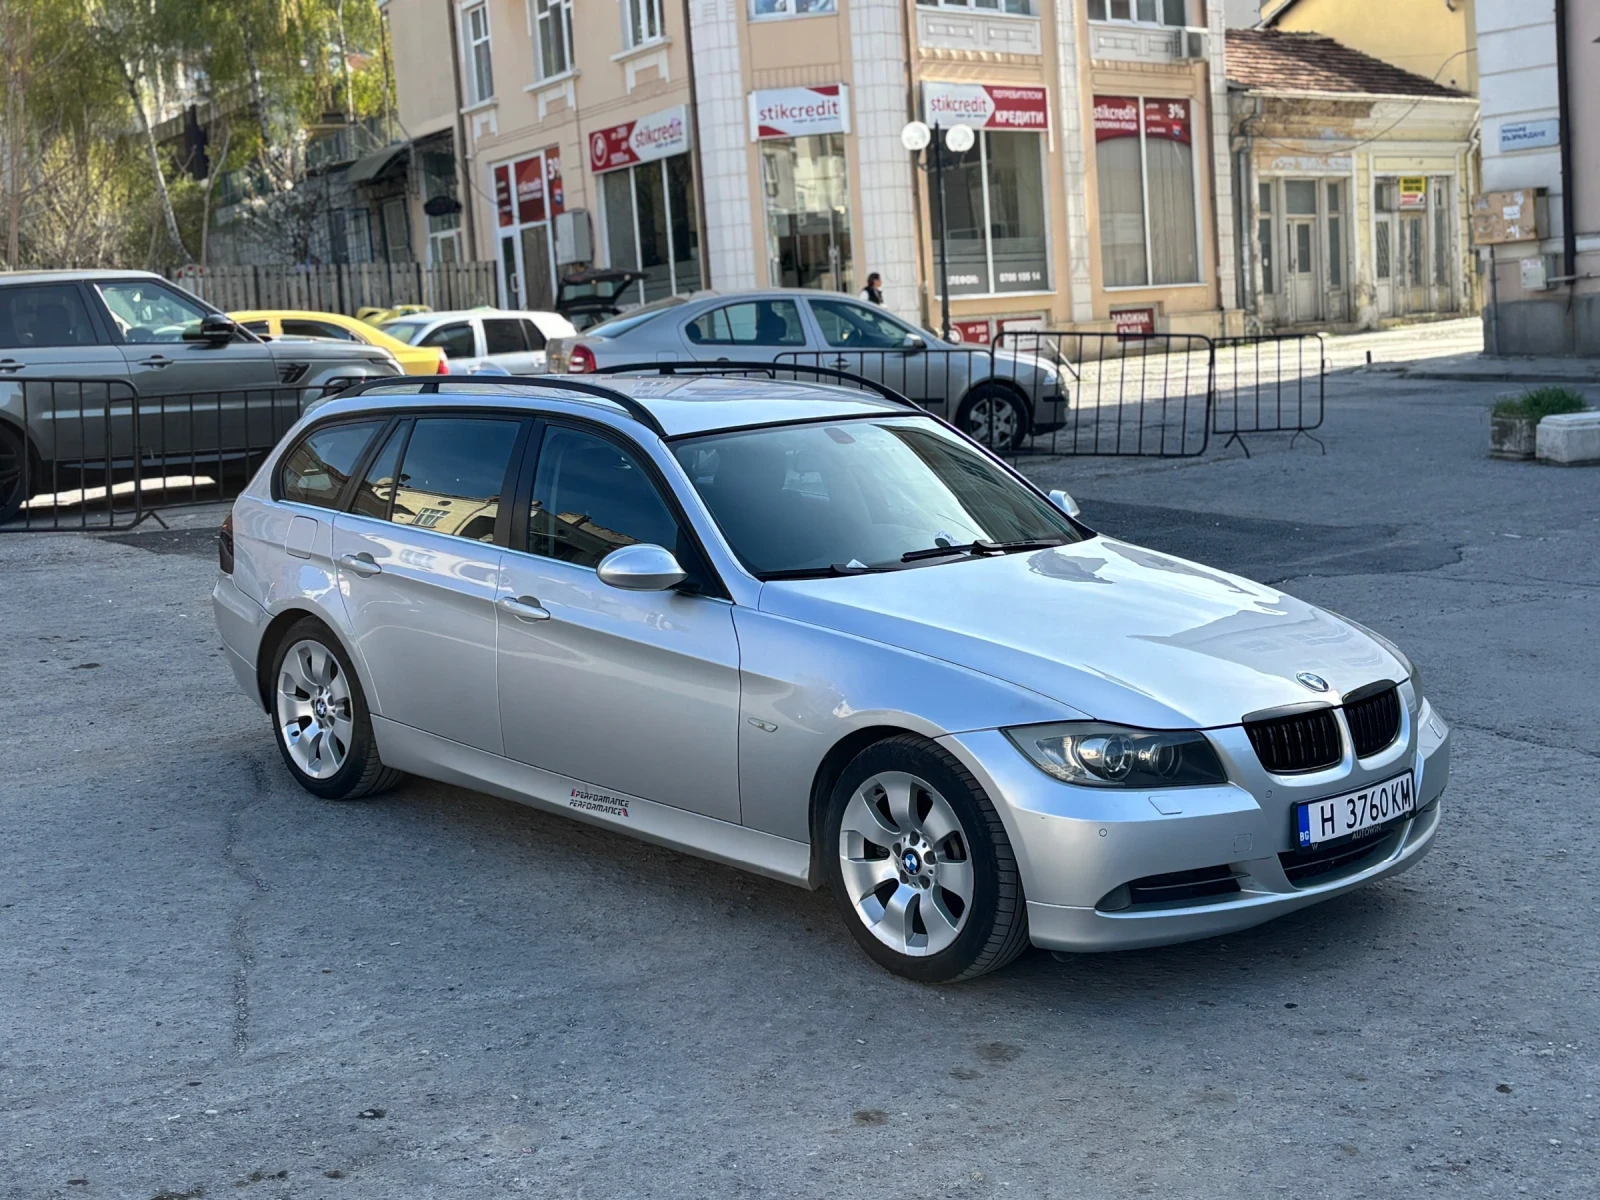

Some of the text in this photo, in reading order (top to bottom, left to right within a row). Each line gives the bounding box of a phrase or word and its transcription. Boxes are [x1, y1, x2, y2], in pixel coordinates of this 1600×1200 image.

[759, 99, 839, 121] stikcredit
[930, 95, 988, 113] stikcredit
[1094, 104, 1137, 121] stikcredit
[1167, 103, 1186, 119] 3%
[995, 110, 1044, 126] КРЕДИТИ
[635, 118, 683, 149] stikcredit
[569, 799, 622, 816] PERFORMANCE
[576, 790, 630, 808] PERFORMANCE
[1320, 777, 1411, 837] H 3760 KM
[1299, 830, 1310, 842] BG
[1351, 823, 1382, 840] AUTOWIN
